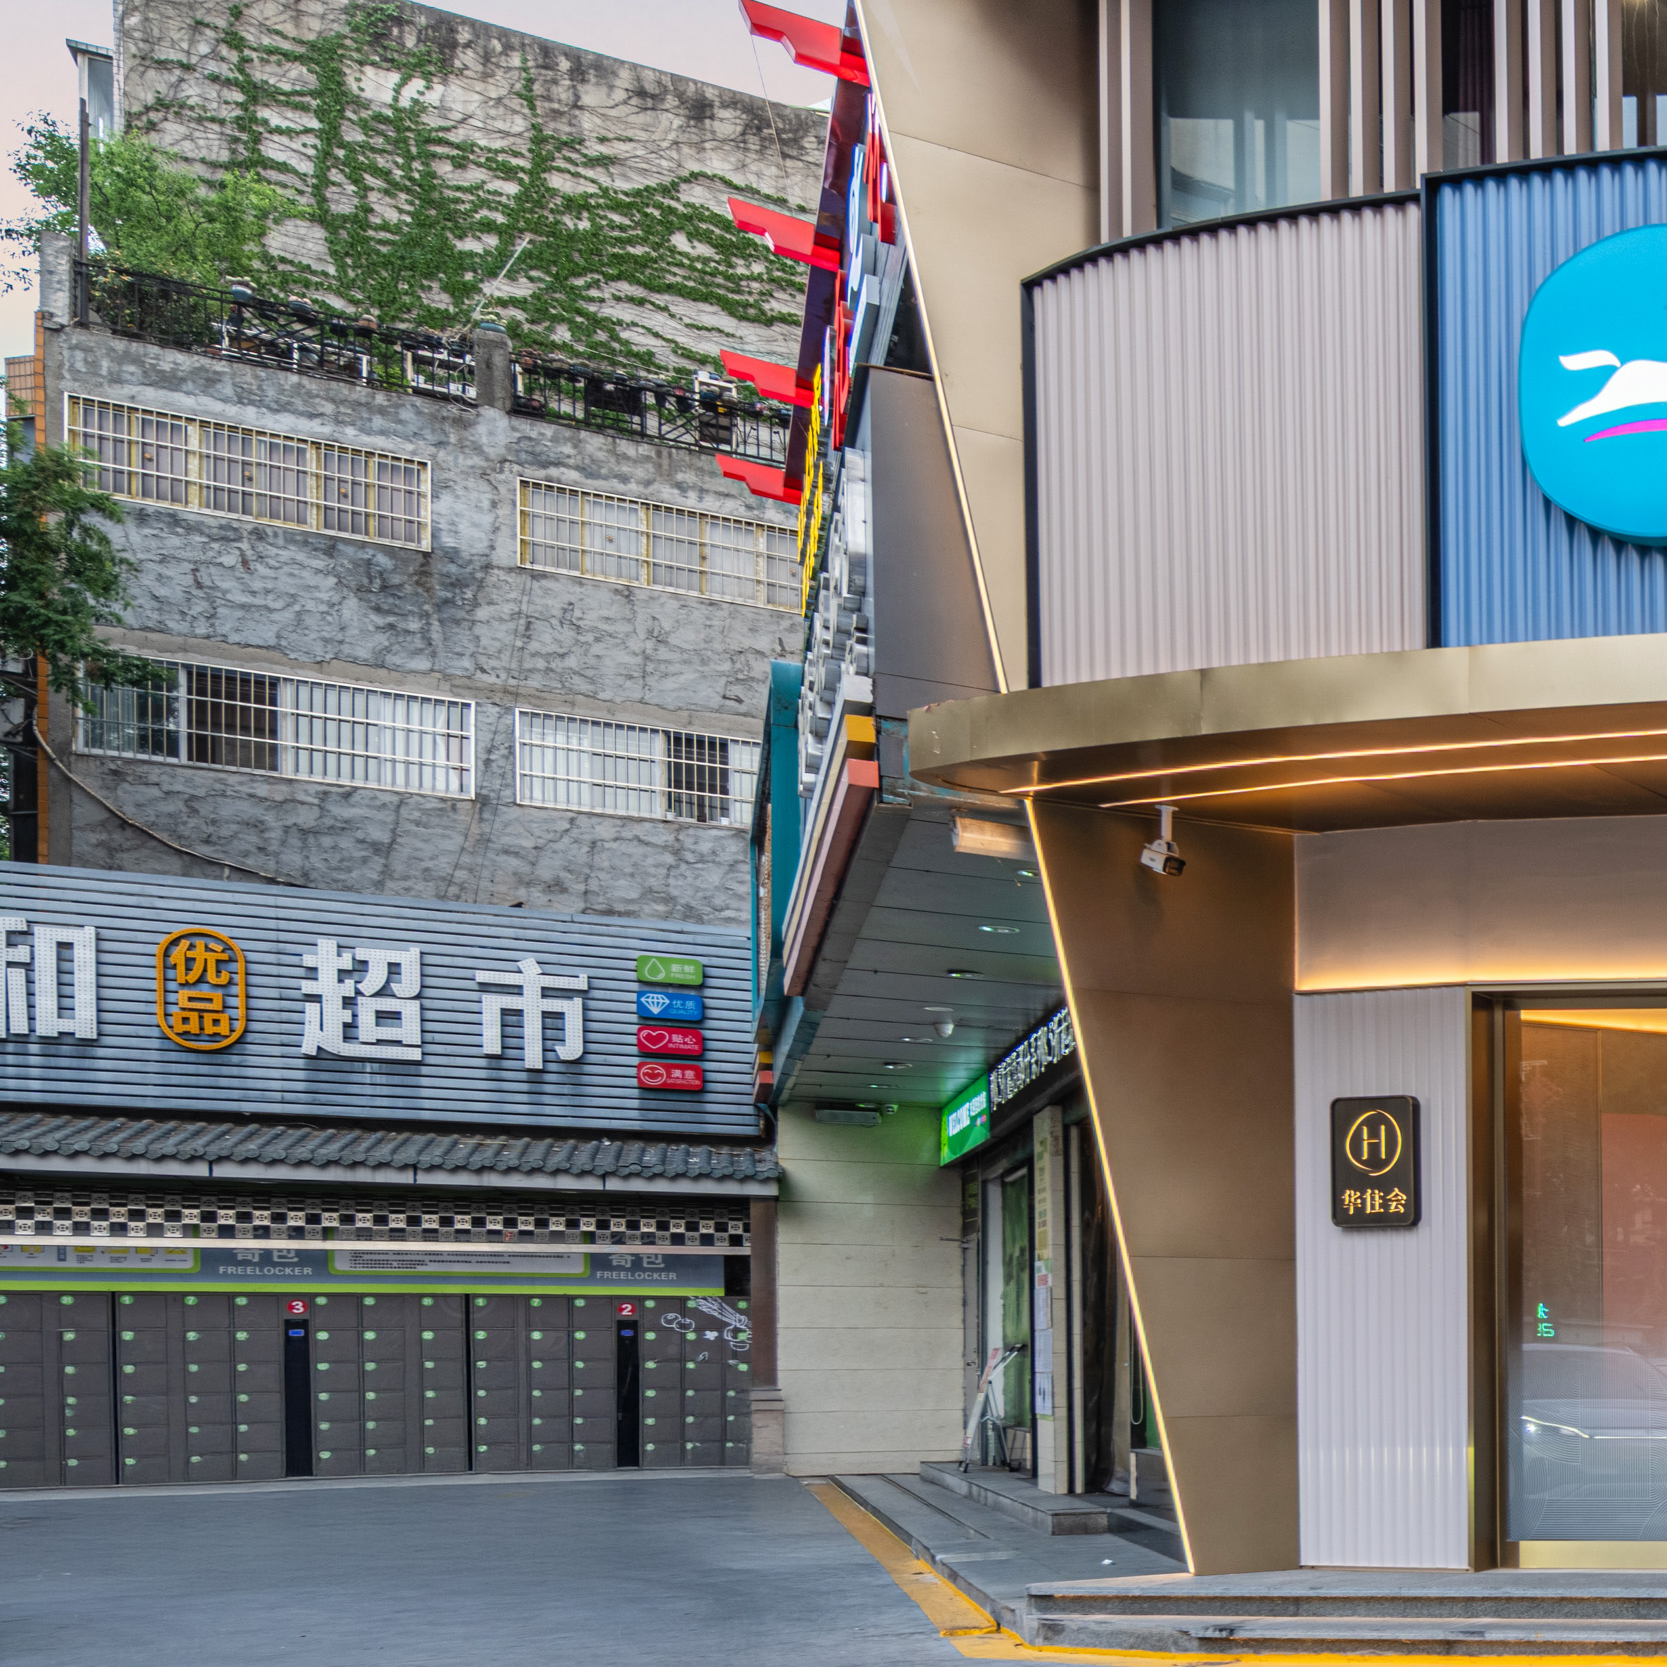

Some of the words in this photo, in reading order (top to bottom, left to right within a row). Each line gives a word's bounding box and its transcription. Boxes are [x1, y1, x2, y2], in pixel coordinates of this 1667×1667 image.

[671, 963, 696, 974] 新鲜
[0, 917, 97, 1040] 和
[169, 939, 231, 1037] 优品
[300, 938, 589, 1070] 超市
[672, 998, 697, 1010] 优质
[671, 1033, 697, 1045] 贴心
[667, 1043, 700, 1051] INTIMATE
[671, 1068, 696, 1080] 满意
[1341, 1187, 1407, 1215] 华住会
[219, 1266, 313, 1275] FREELOCKER
[596, 1271, 677, 1280] FREELOCKER
[291, 1301, 305, 1314] 3
[621, 1303, 633, 1315] 2
